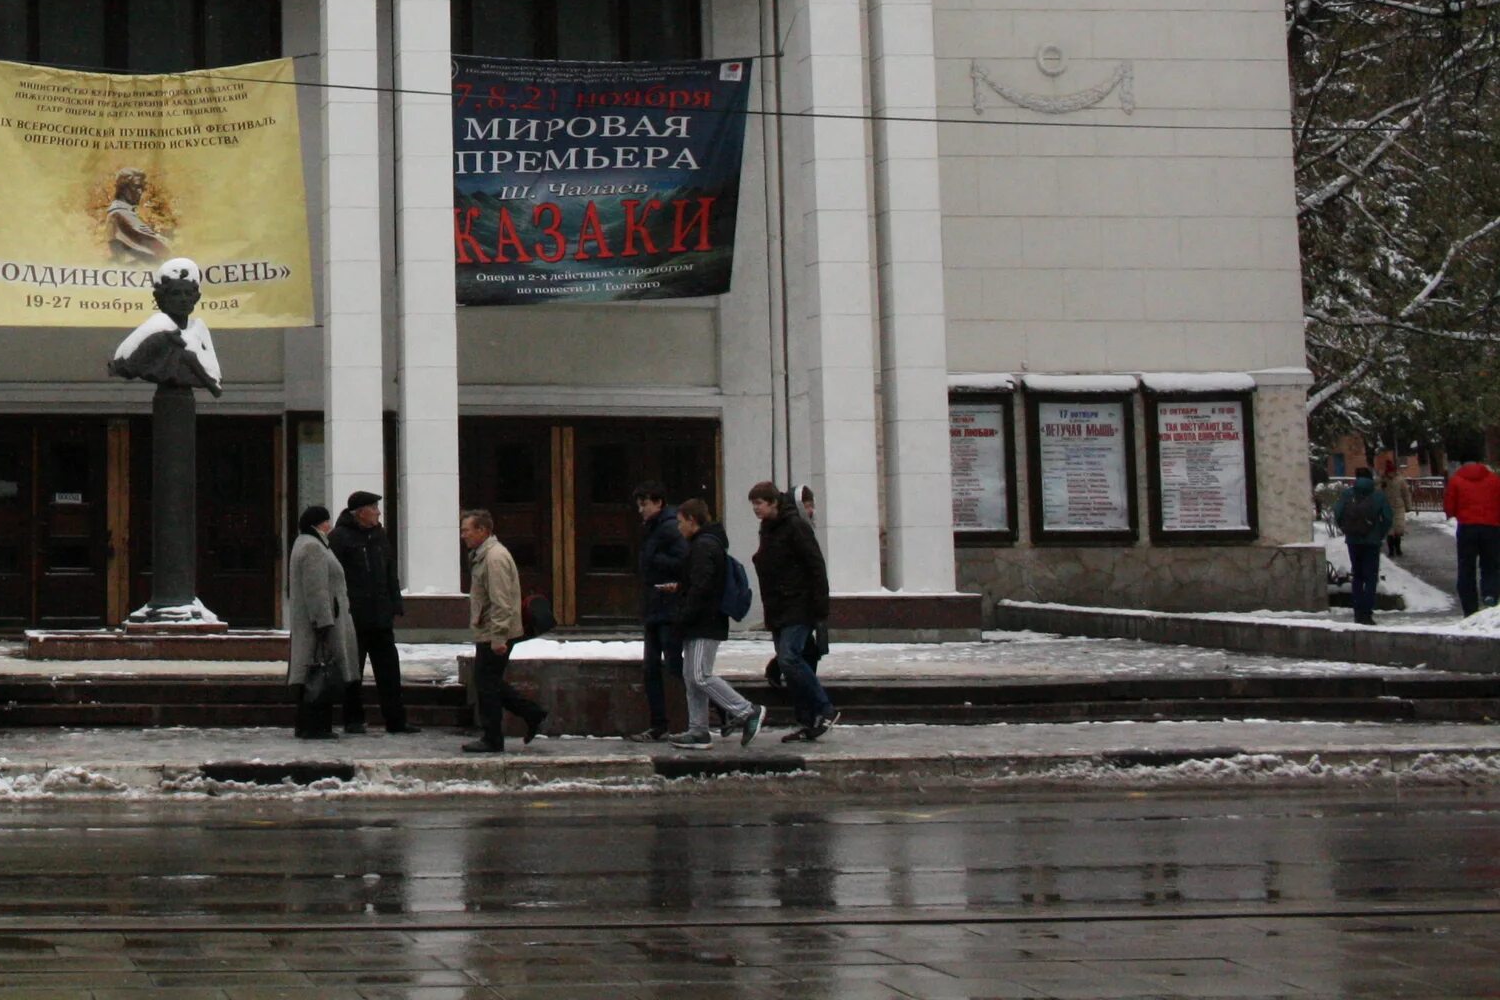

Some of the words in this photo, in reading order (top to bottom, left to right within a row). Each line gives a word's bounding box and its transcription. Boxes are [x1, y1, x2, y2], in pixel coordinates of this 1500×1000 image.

[575, 84, 713, 112] ноября
[205, 116, 276, 134] ФЕСТИВАЛЬ
[464, 115, 691, 142] МИРОВАЯ
[24, 133, 89, 148] ОПЕРНОГО
[170, 135, 240, 149] ИСКУССТВА
[455, 147, 701, 174] ПРЕМЬЕРА
[500, 184, 536, 200] Ш.
[549, 181, 649, 197] Чалаев
[454, 196, 719, 264] КАЗАКИ
[198, 261, 291, 285] СЕНЬ»
[476, 272, 516, 285] Опера
[628, 263, 694, 279] прологом
[534, 285, 584, 295] повести
[605, 280, 661, 293] Толстого
[25, 295, 72, 309] 19-27
[79, 297, 144, 313] ноября
[201, 296, 240, 311] года
